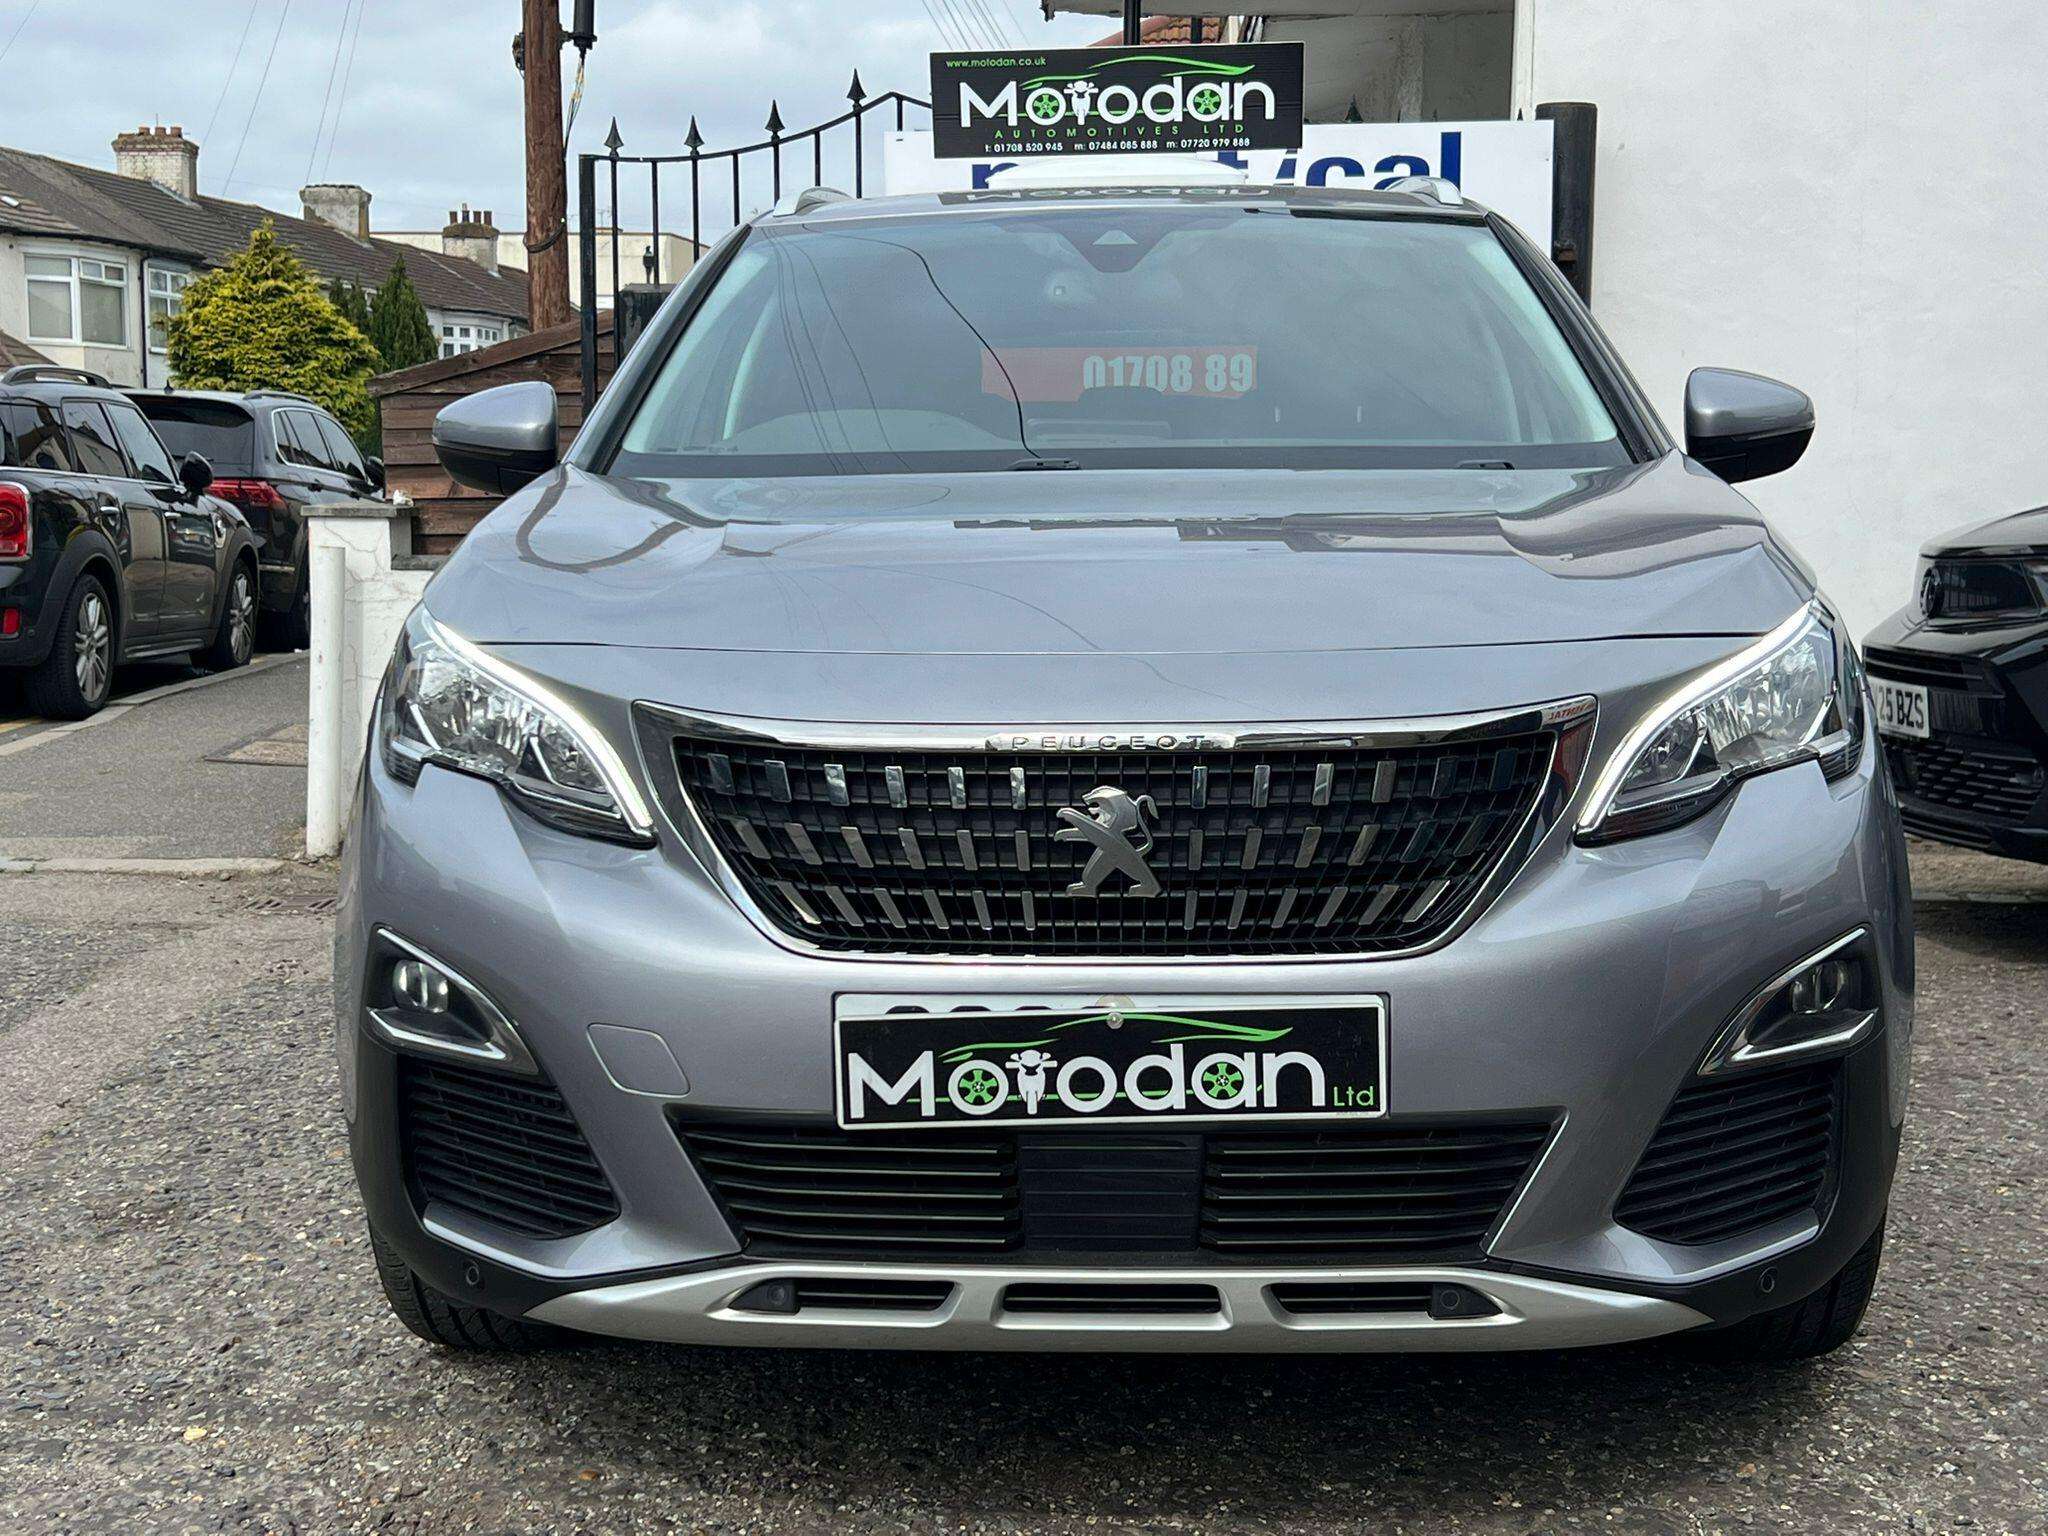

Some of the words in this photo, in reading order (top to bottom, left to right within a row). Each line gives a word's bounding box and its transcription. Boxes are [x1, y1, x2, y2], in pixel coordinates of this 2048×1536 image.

[945, 56, 1047, 68] www.motodan.co.uk
[959, 76, 1275, 128] Motodan
[994, 126, 1179, 139] AUTOMOTIVES
[1203, 124, 1244, 134] LTD
[994, 143, 1023, 153] 01708
[1025, 143, 1043, 152] 520
[1045, 142, 1063, 152] 945
[1088, 141, 1118, 150] 07484
[1212, 138, 1230, 148] 979
[1232, 137, 1250, 147] 888
[1083, 354, 1193, 393] 01708
[1204, 353, 1253, 393] 89
[1896, 689, 1924, 730] BZS
[1011, 734, 1206, 751] PEUGEOT
[848, 1043, 1326, 1119] Motodan
[1333, 1085, 1374, 1107] Ltd
